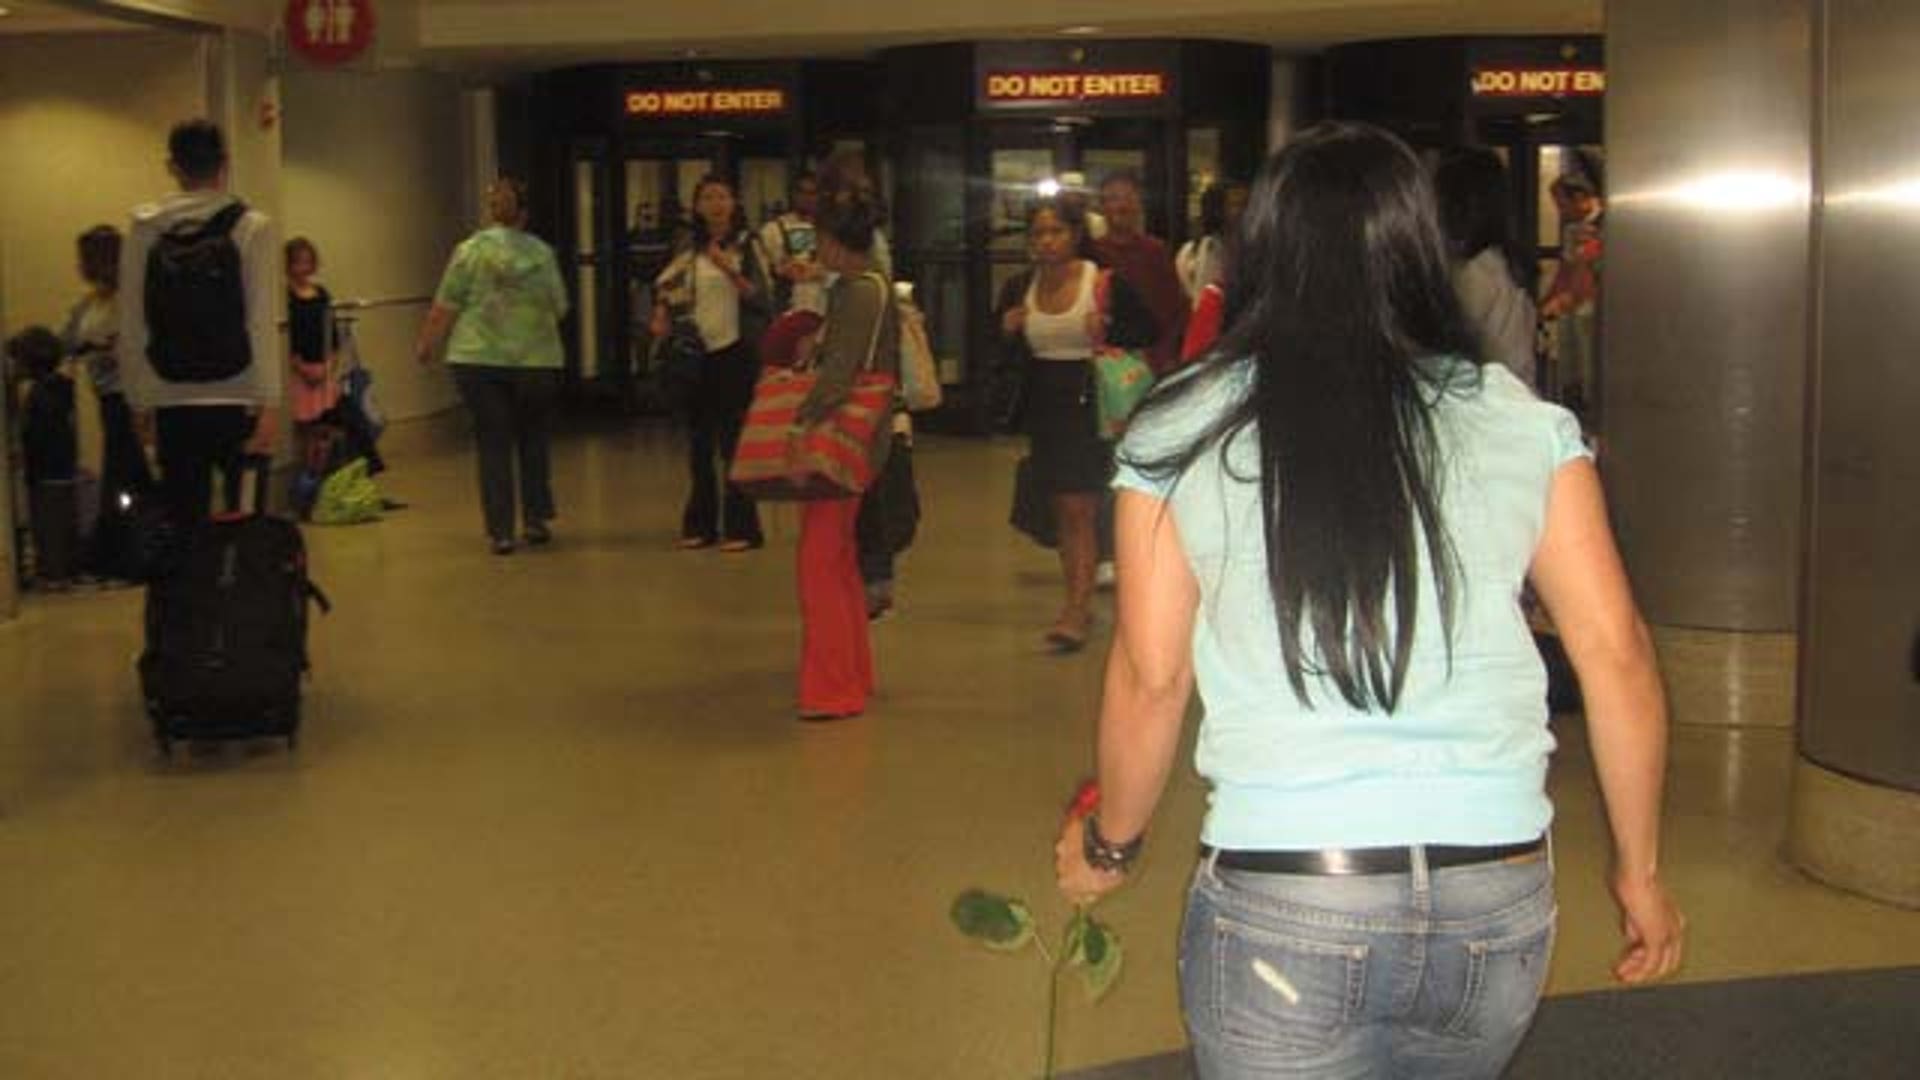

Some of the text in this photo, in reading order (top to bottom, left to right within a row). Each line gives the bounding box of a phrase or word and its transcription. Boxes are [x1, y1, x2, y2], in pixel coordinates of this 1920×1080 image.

[988, 74, 1161, 96] DO NOT ENTER
[1480, 71, 1516, 91] DO
[1520, 71, 1570, 91] NOT
[628, 89, 782, 112] DO NOT ENTER
